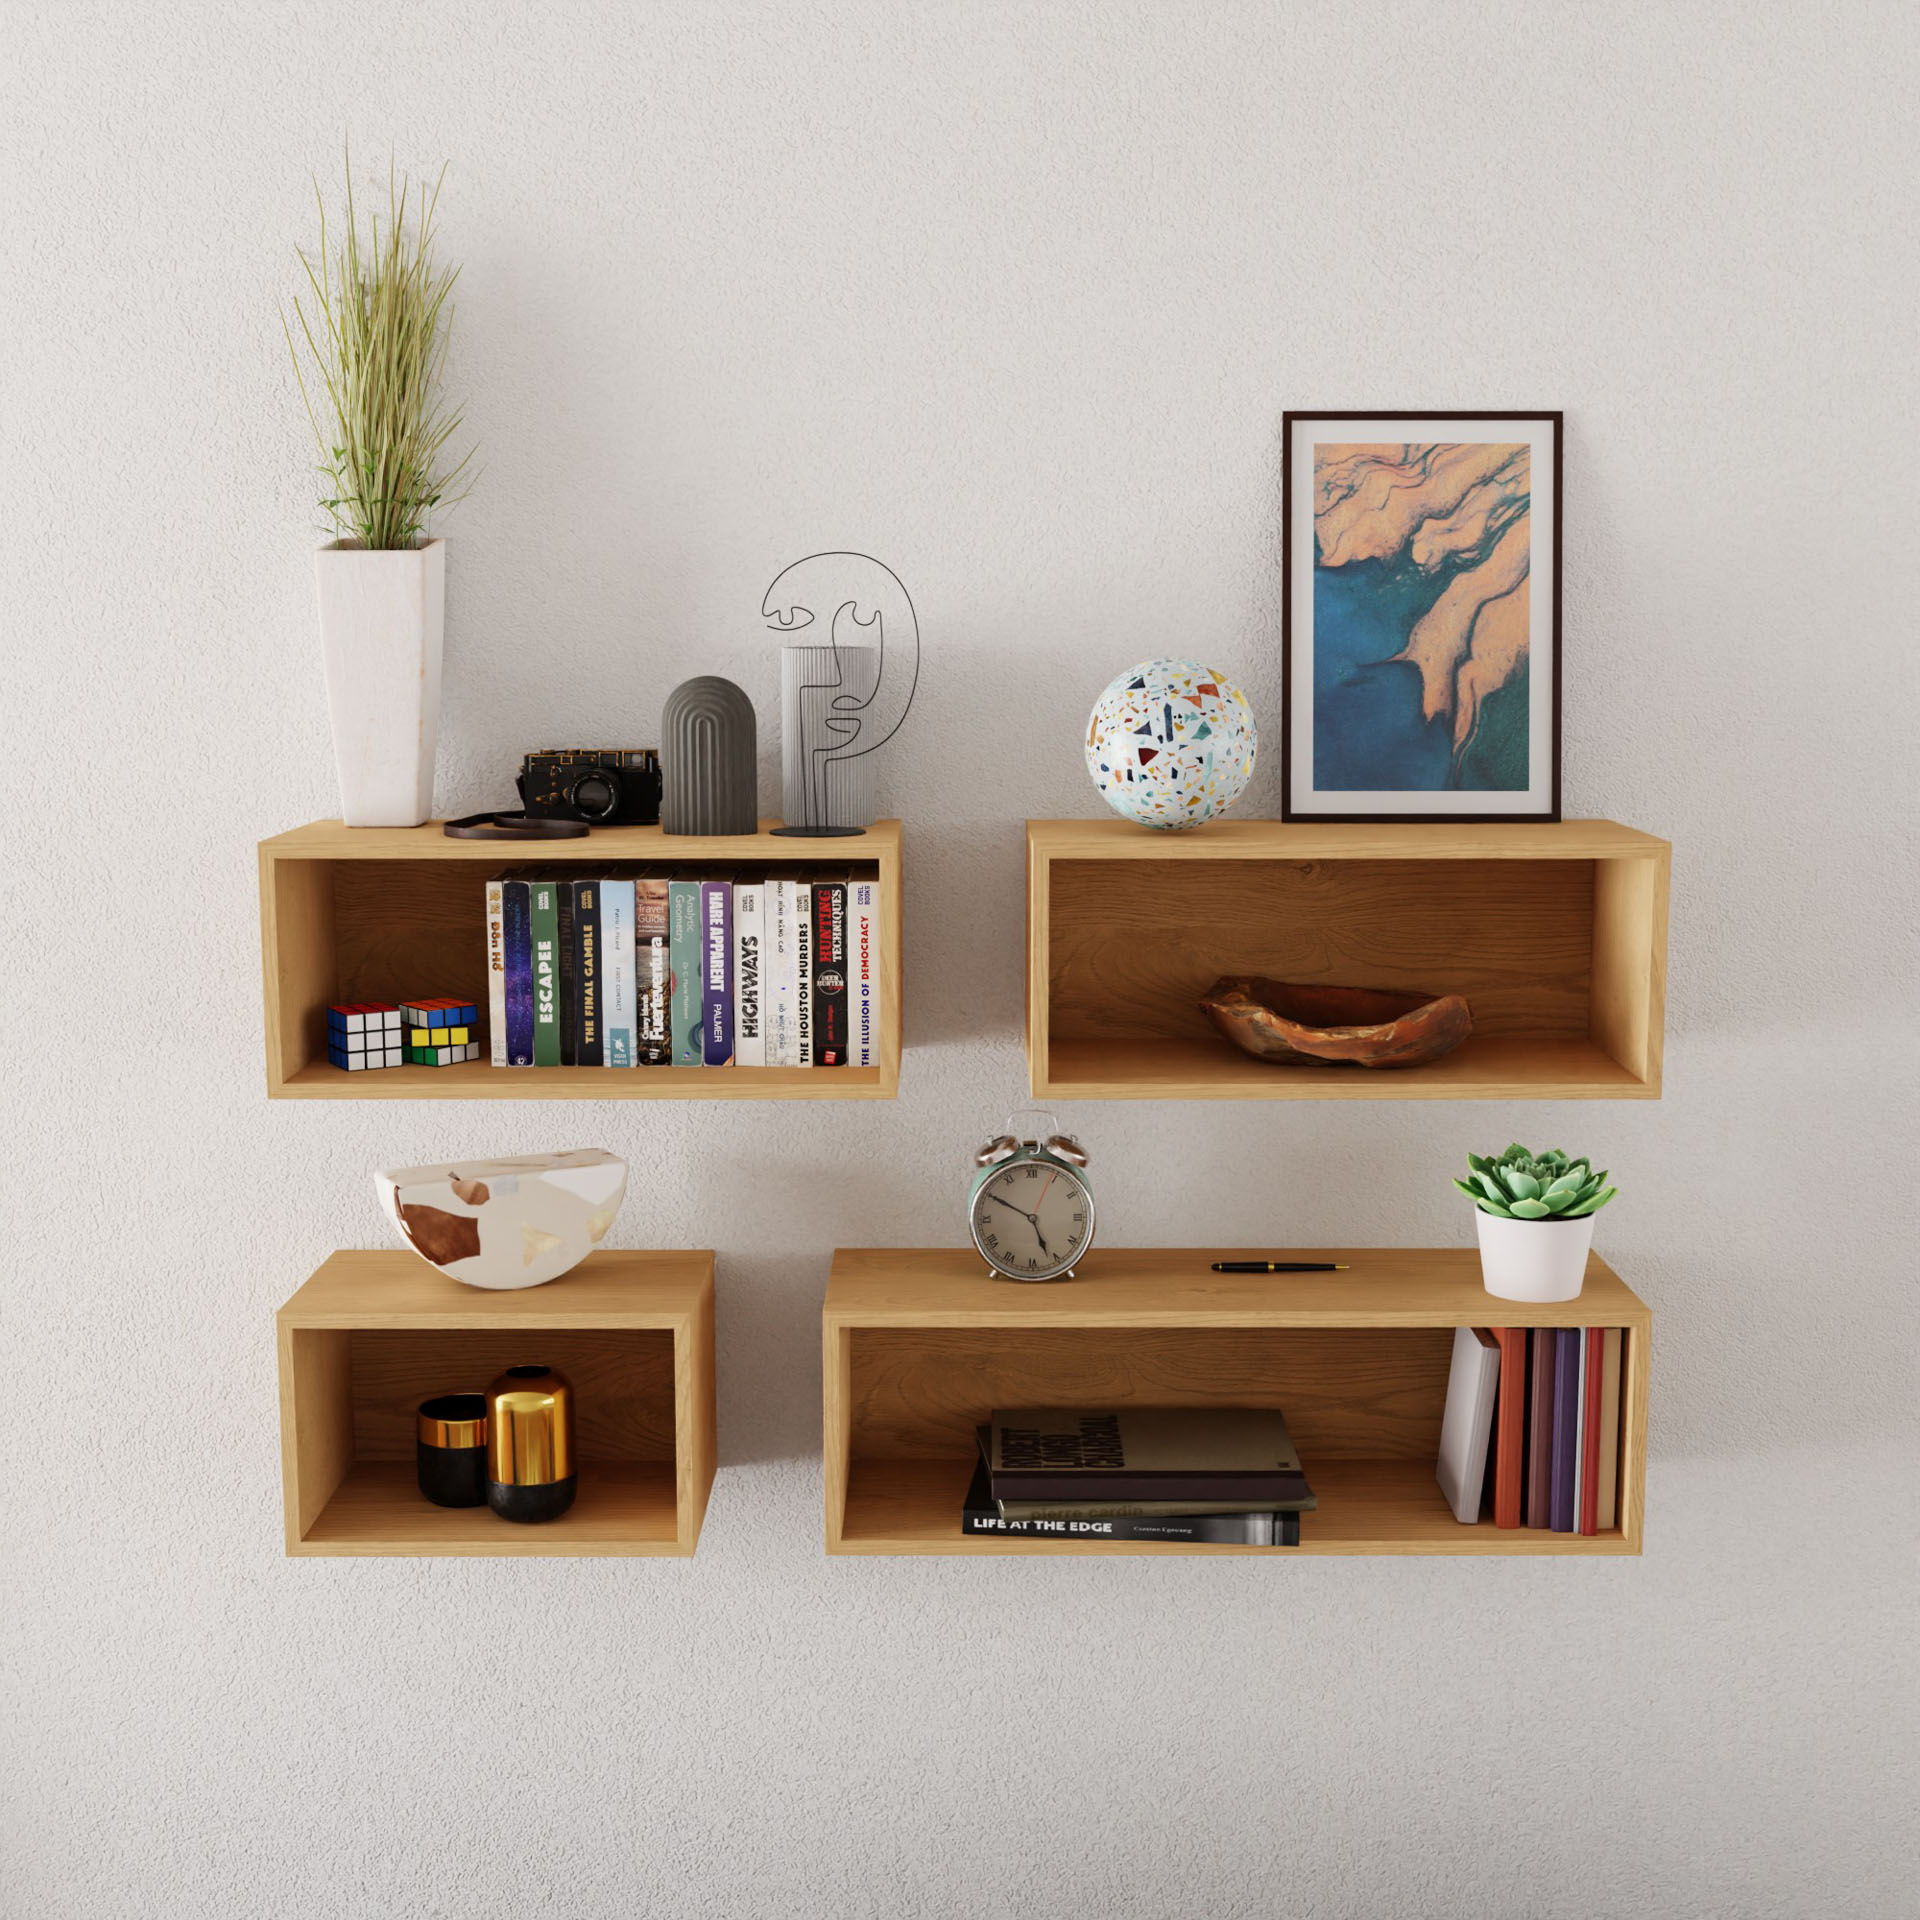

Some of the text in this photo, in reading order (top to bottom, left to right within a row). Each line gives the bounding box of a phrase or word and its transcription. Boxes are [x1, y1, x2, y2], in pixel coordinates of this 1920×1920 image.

[638, 914, 664, 923] Guide
[639, 904, 664, 913] Travel
[674, 894, 685, 943] Geometry
[686, 894, 695, 932] Analytic
[709, 892, 724, 992] HARE APPARENT
[819, 890, 832, 963] HUNTING
[832, 889, 844, 962] TECHNIQUES
[538, 941, 553, 1023] ESCAPEE
[584, 925, 594, 1044] THE FINAL GAMBLE
[649, 936, 664, 1040] Fuerteventura
[741, 936, 759, 1038] HIGHWAYS
[799, 923, 808, 1063] THE HOUSTON MURDERS
[860, 916, 870, 1066] THE ILLUSION OF DEMOCRACY
[713, 1004, 722, 1043] PALMER
[1026, 1169, 1037, 1178] XII
[973, 1518, 1113, 1532] LIFE AT THE EDGE
[1031, 1508, 1082, 1520] pierre
[1089, 1505, 1143, 1518] cardin
